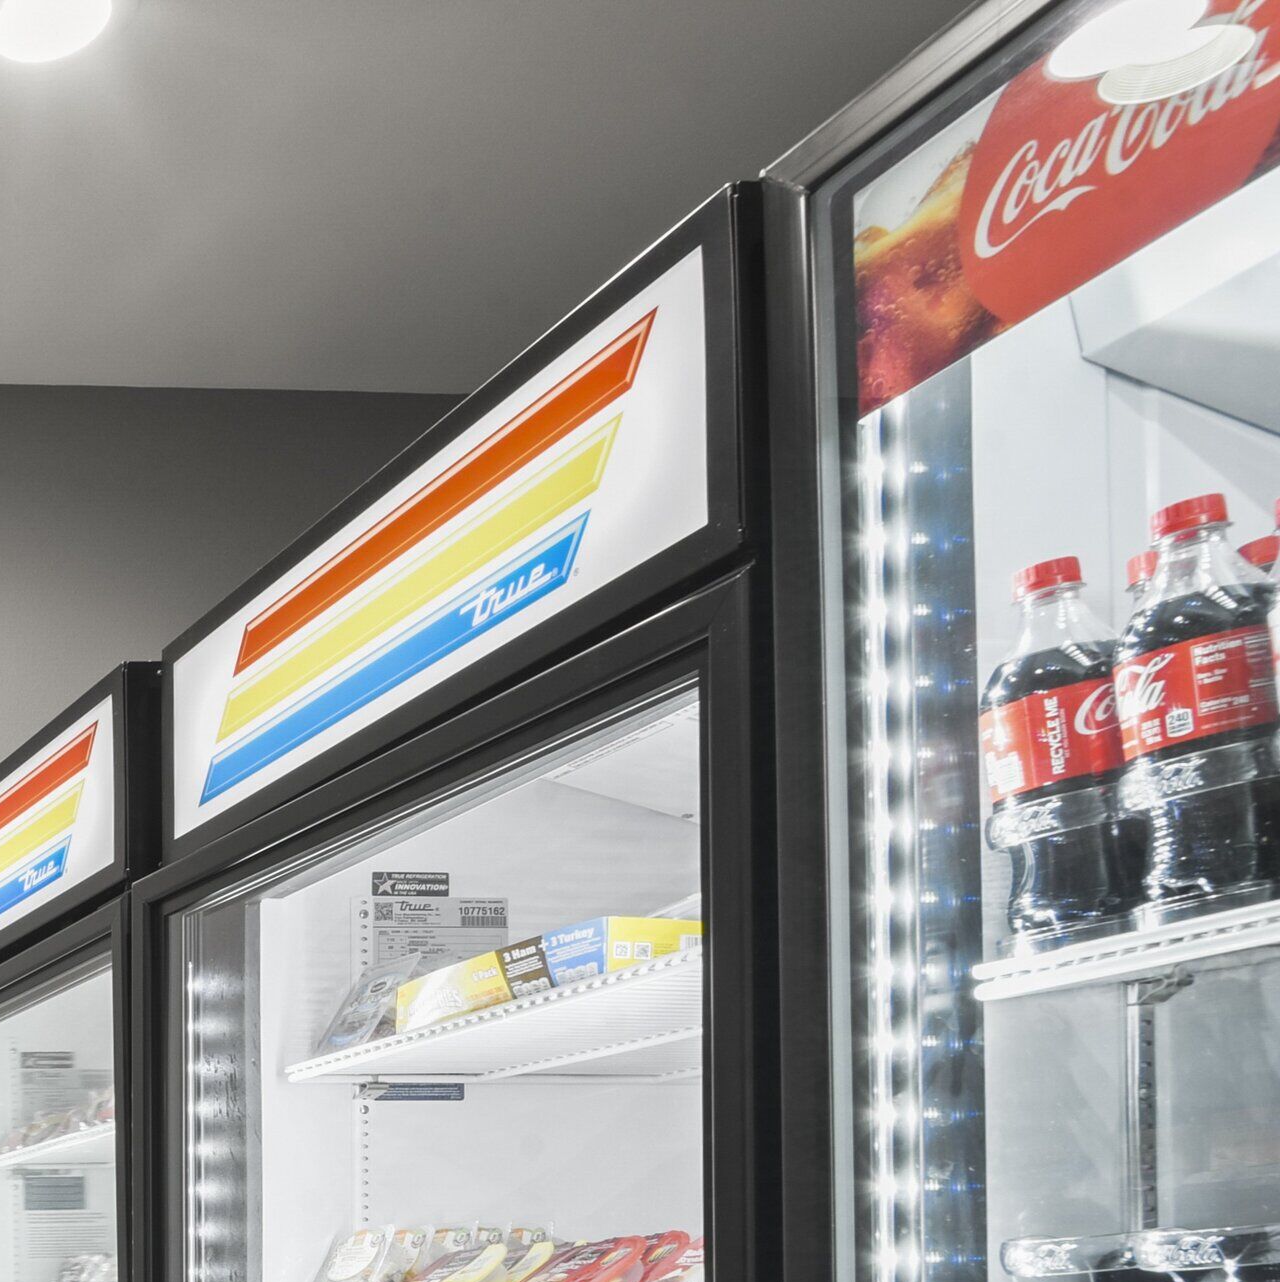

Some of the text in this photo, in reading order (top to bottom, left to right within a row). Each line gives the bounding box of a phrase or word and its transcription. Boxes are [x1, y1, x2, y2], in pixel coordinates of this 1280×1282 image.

[1169, 711, 1189, 726] 240
[1044, 696, 1066, 776] RECYCLE ME
[395, 883, 445, 892] INNOVATION
[459, 907, 506, 916] 10775162
[503, 951, 511, 963] 3
[512, 944, 536, 960] Ham
[551, 936, 558, 948] 3
[558, 926, 596, 946] Turkey
